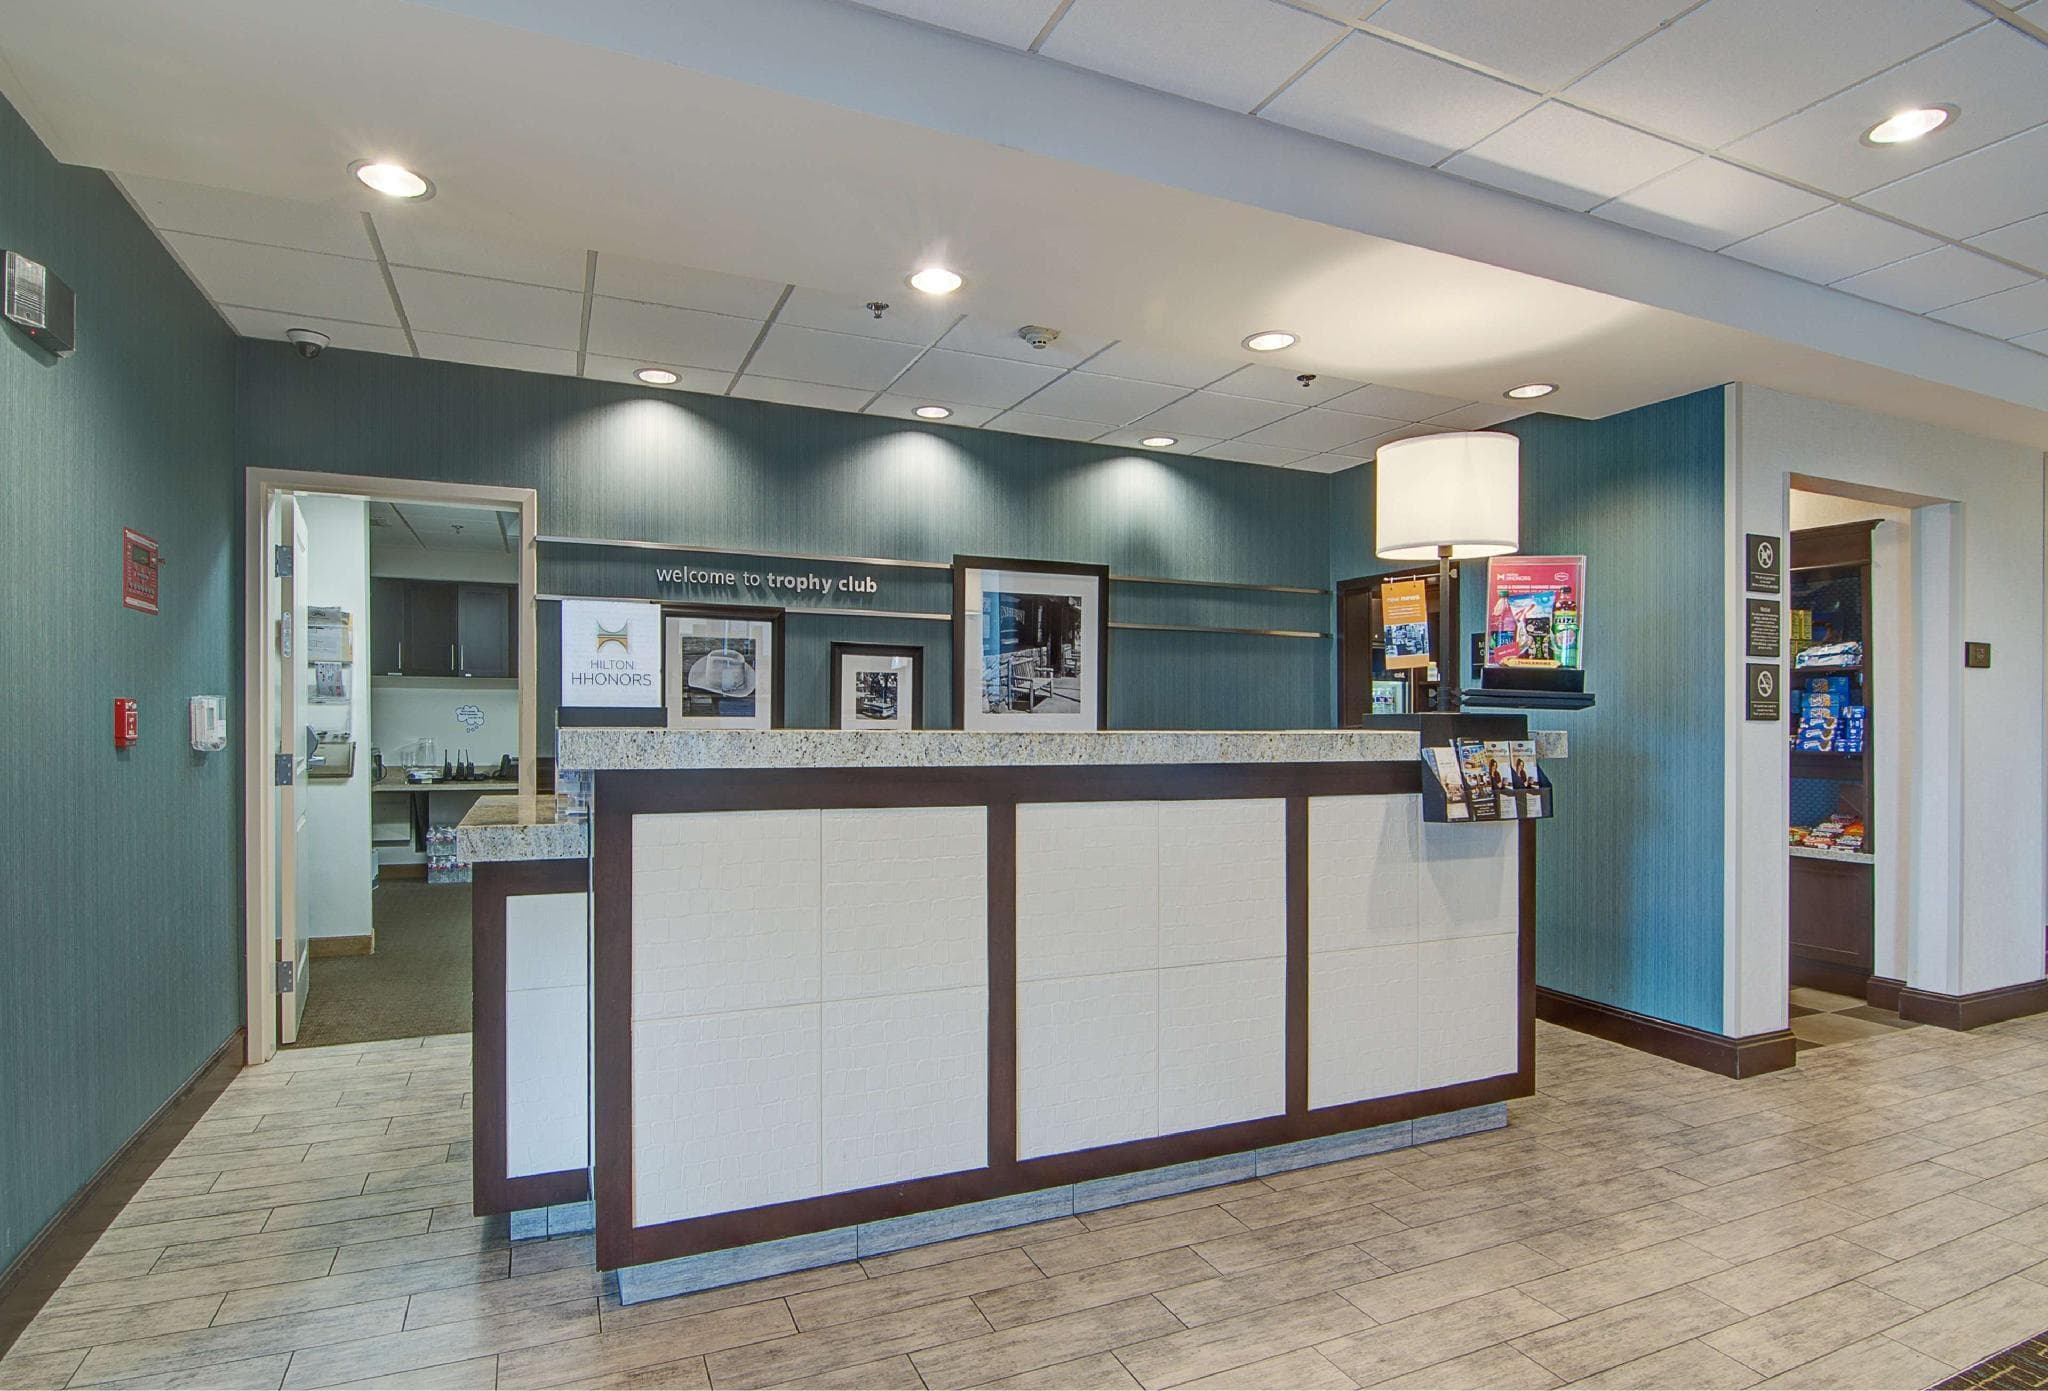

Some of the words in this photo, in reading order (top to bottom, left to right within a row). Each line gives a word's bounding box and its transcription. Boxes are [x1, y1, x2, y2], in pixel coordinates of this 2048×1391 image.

[656, 566, 736, 585] welcome
[743, 571, 760, 586] to
[767, 573, 832, 593] trophy
[838, 576, 878, 593] club
[590, 660, 634, 670] HILTON
[571, 672, 653, 686] HHONORS
